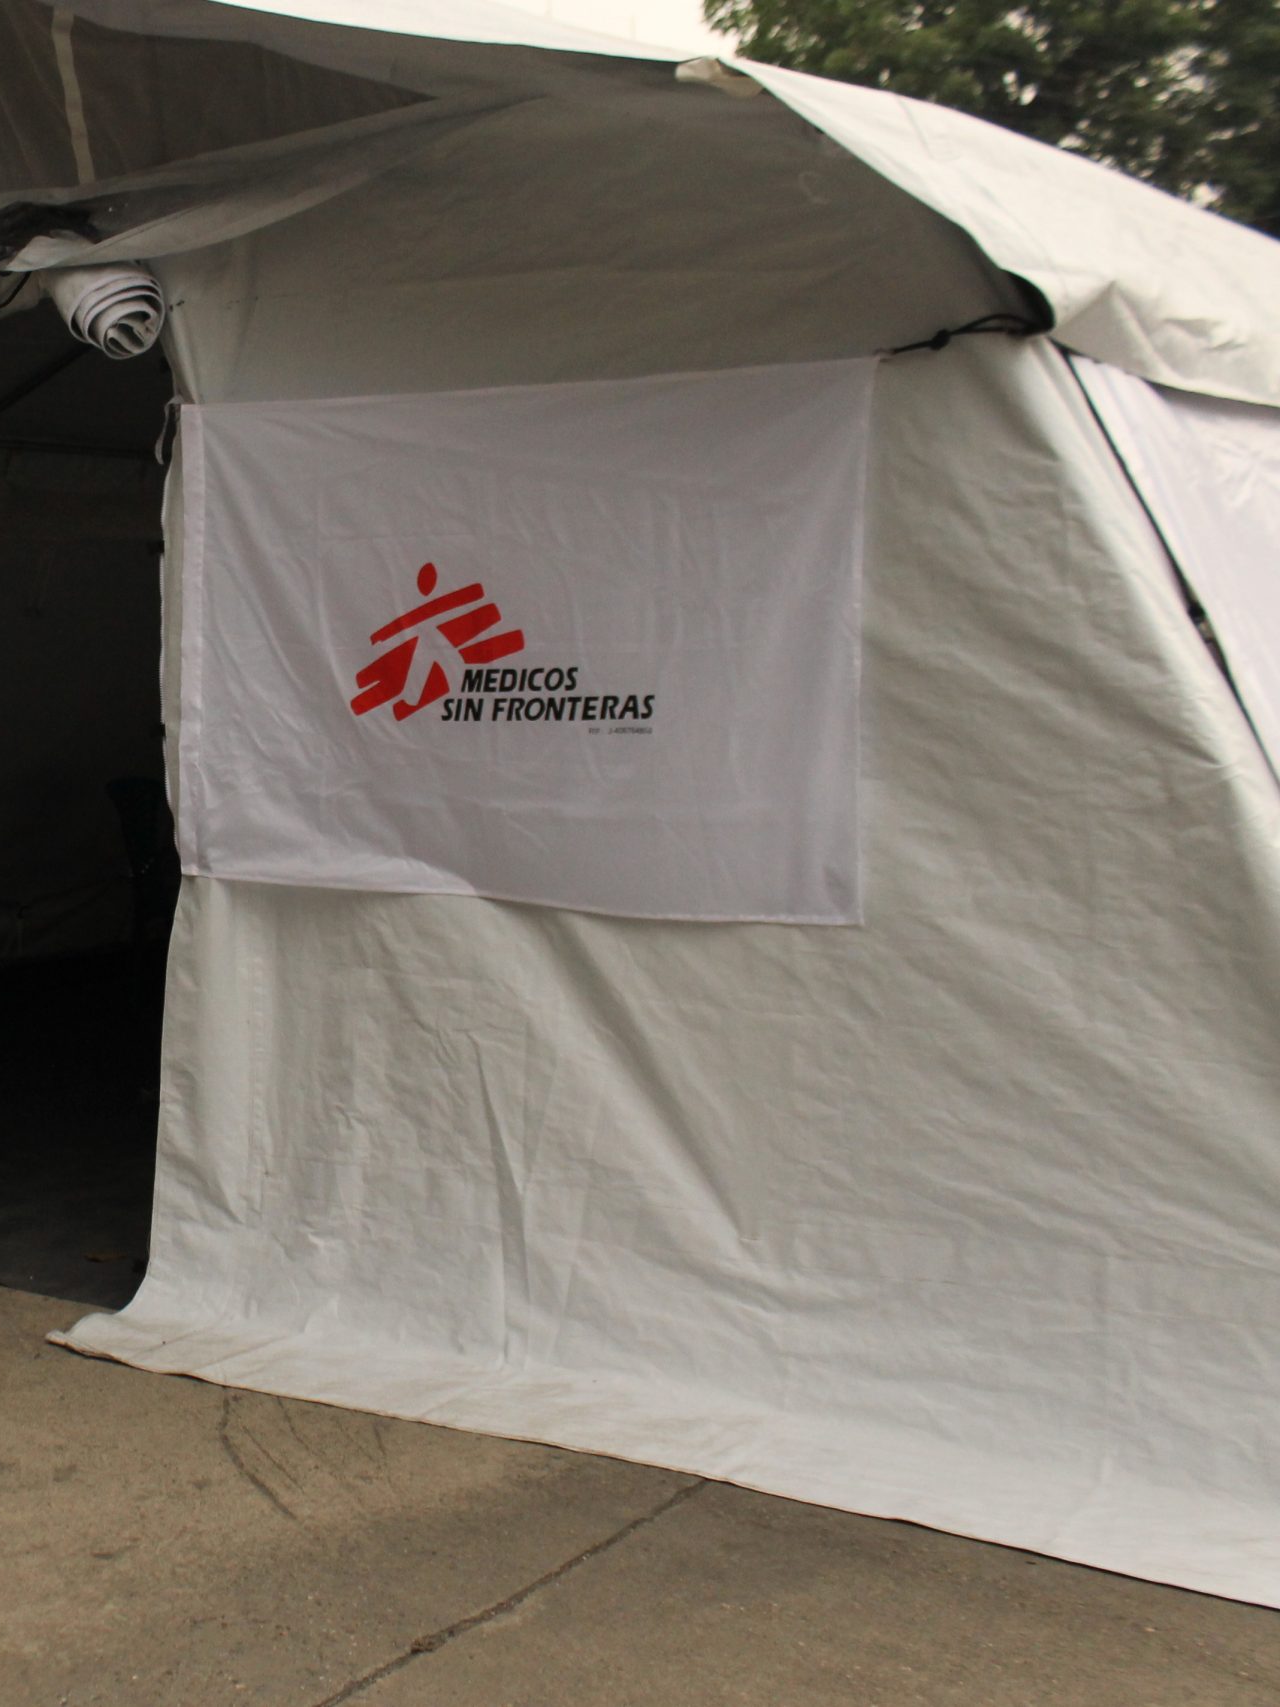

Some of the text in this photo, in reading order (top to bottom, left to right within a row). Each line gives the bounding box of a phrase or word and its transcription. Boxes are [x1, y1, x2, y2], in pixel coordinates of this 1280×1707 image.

[461, 667, 578, 692] MEDICOS
[440, 695, 655, 721] SIN FRONTERAS
